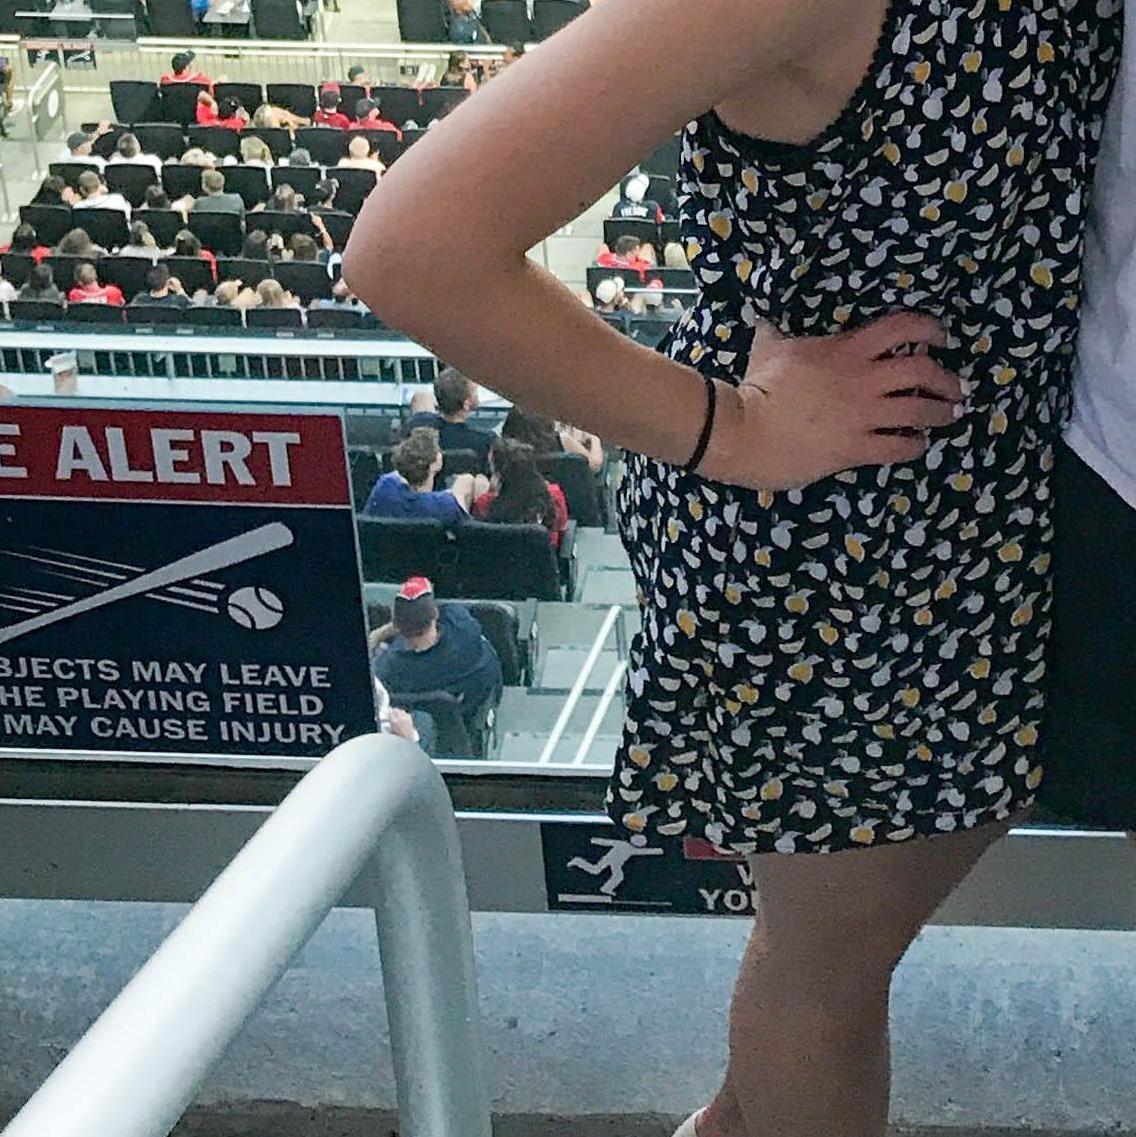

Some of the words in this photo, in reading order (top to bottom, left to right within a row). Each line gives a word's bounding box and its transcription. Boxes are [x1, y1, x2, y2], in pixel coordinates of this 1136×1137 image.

[55, 425, 301, 487] ALERT
[132, 661, 207, 685] MAY
[220, 664, 331, 689] LEAVE
[57, 686, 210, 713] PLAYING
[223, 692, 325, 717] FIELD
[4, 713, 86, 737] MAY
[91, 717, 209, 741] CAUSE
[220, 721, 346, 746] INJURY
